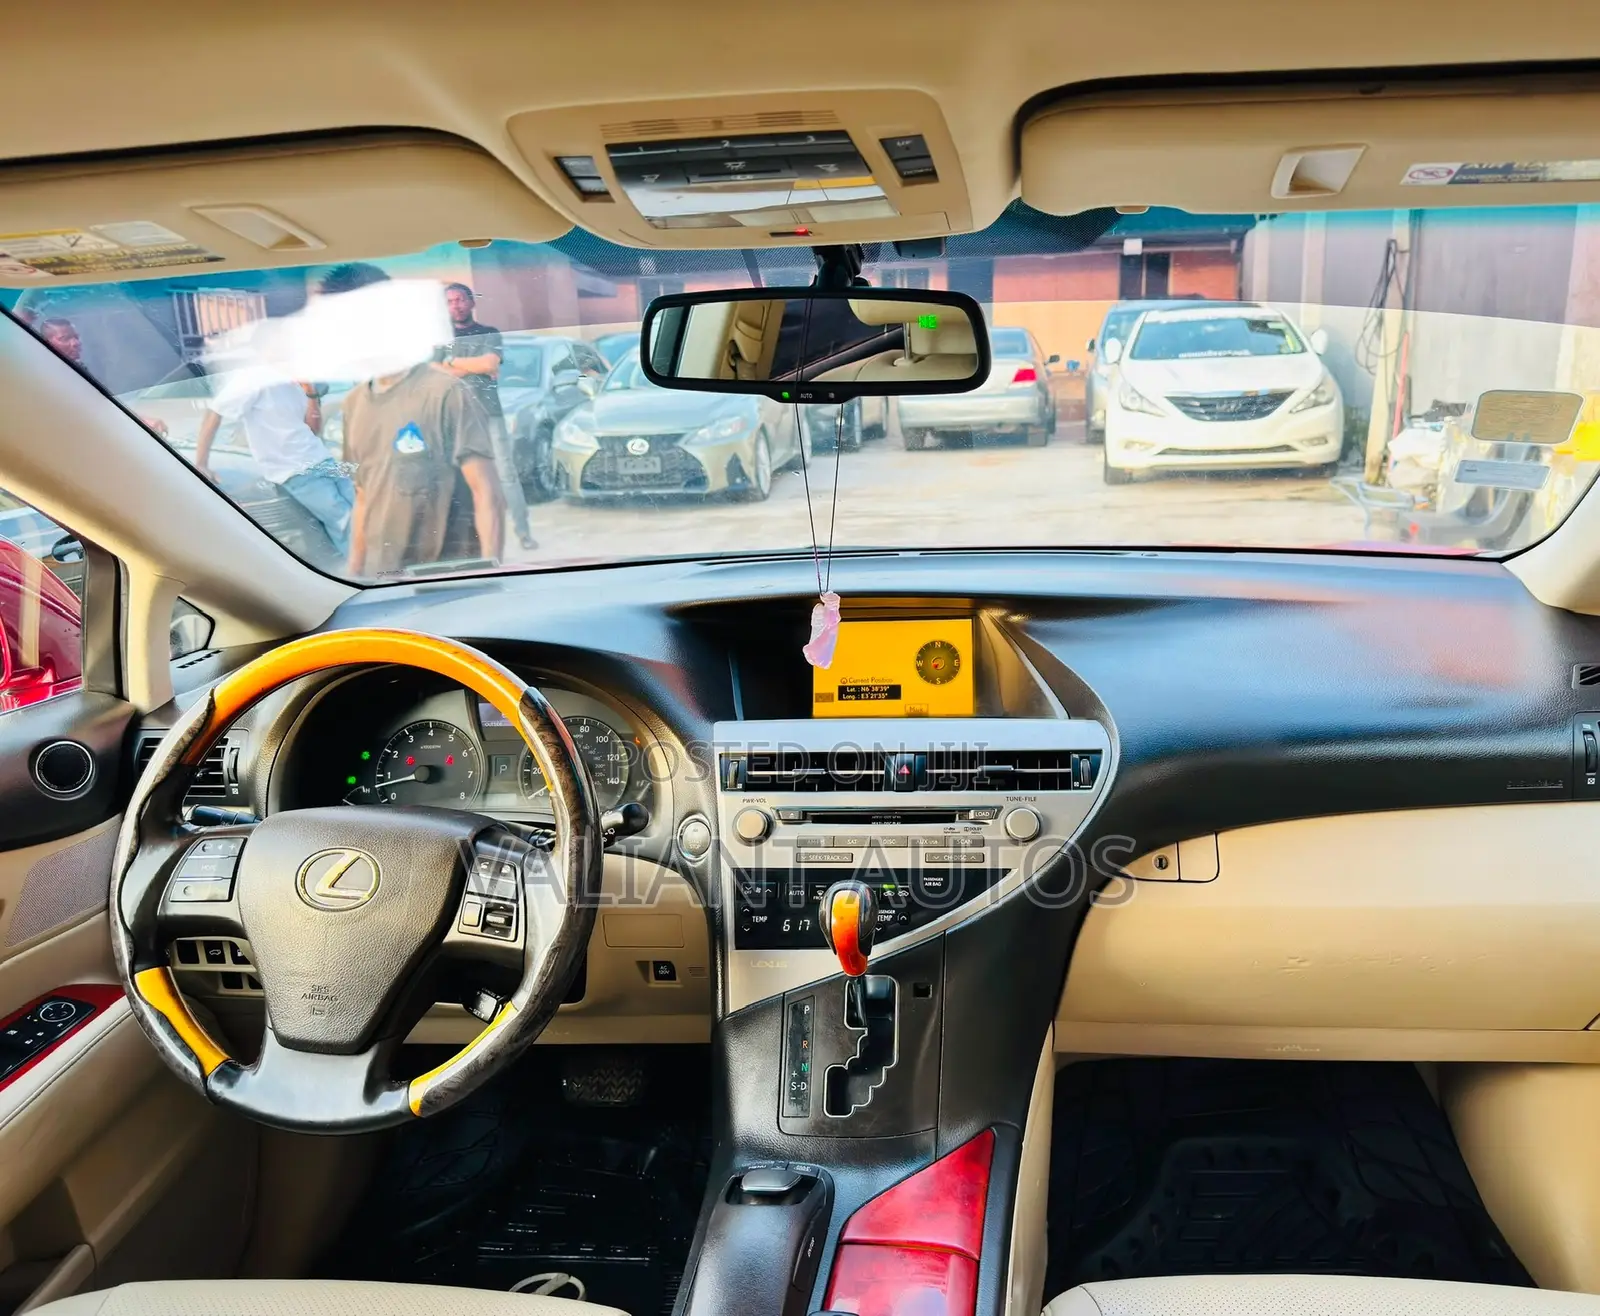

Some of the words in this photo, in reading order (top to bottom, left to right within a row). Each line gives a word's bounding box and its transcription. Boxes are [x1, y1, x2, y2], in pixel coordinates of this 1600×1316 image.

[428, 729, 434, 737] 4
[392, 751, 398, 759] 2
[462, 750, 468, 758] 6
[500, 764, 508, 774] P
[312, 984, 330, 992] SRS
[301, 992, 338, 1001] AIRBAG
[804, 1004, 810, 1014] P
[802, 1040, 808, 1048] R
[801, 1063, 809, 1072] N
